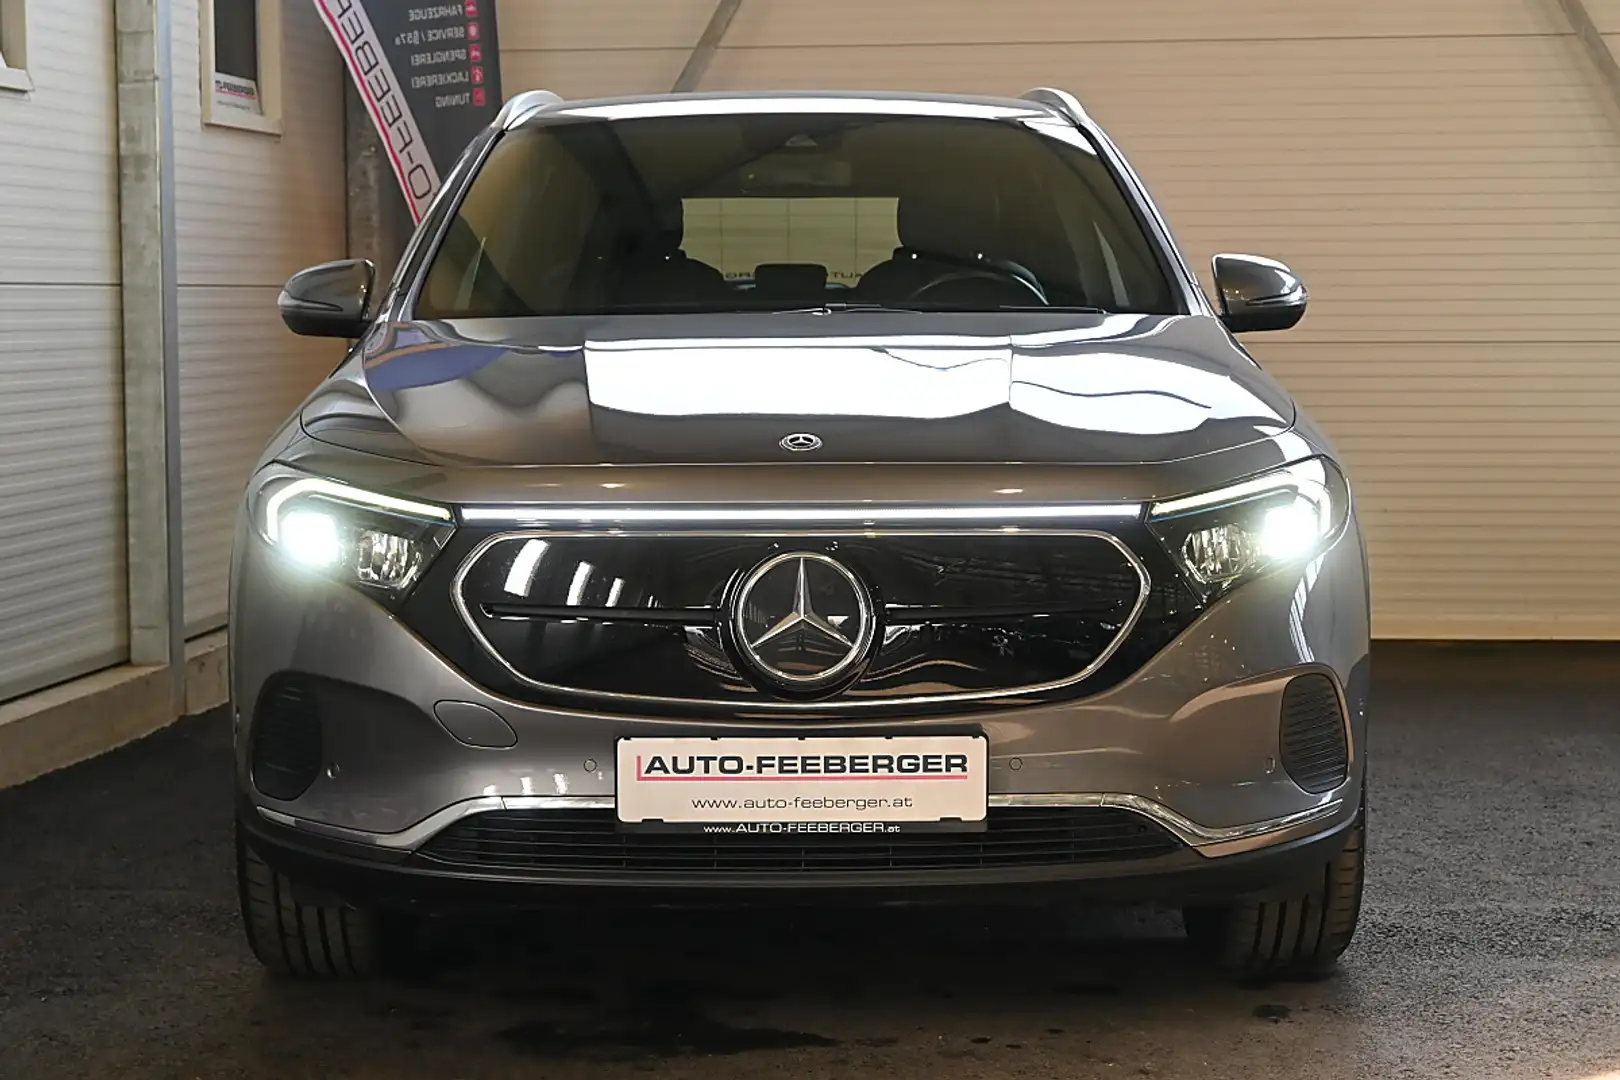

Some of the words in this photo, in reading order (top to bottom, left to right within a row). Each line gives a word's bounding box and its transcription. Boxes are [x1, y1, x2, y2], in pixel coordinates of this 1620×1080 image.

[644, 755, 968, 775] AUTO-FEEBERGER
[691, 796, 913, 811] www.auto-feeberger.at
[703, 822, 901, 833] www.AUTO-FEEBERGER.at
